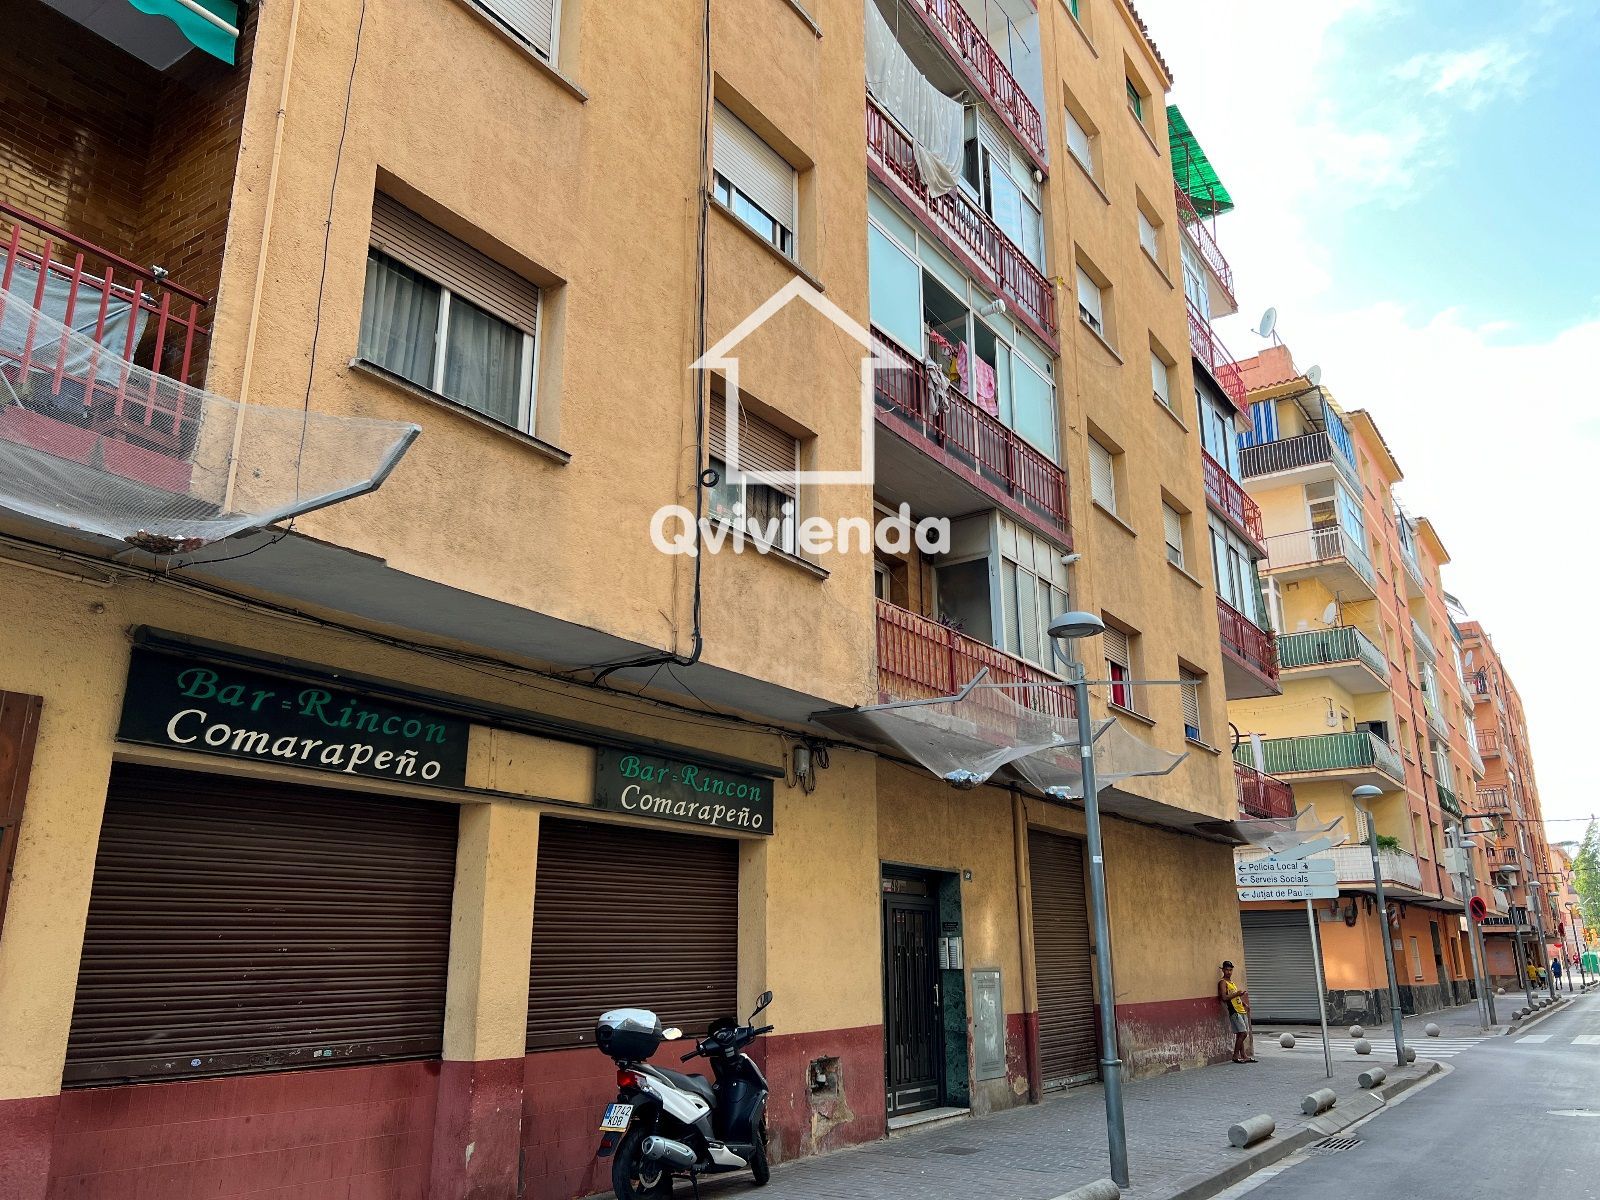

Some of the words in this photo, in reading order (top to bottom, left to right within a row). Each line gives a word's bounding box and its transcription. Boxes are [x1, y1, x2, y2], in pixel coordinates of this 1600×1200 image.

[166, 709, 441, 780] Comarapeño
[621, 784, 763, 829] Comarapeño
[1276, 862, 1298, 870] Local
[1250, 875, 1278, 883] Serveis
[1280, 875, 1309, 883] Socials
[1251, 889, 1274, 899] Jutjat
[1275, 889, 1286, 898] de
[1287, 889, 1303, 897] Pau
